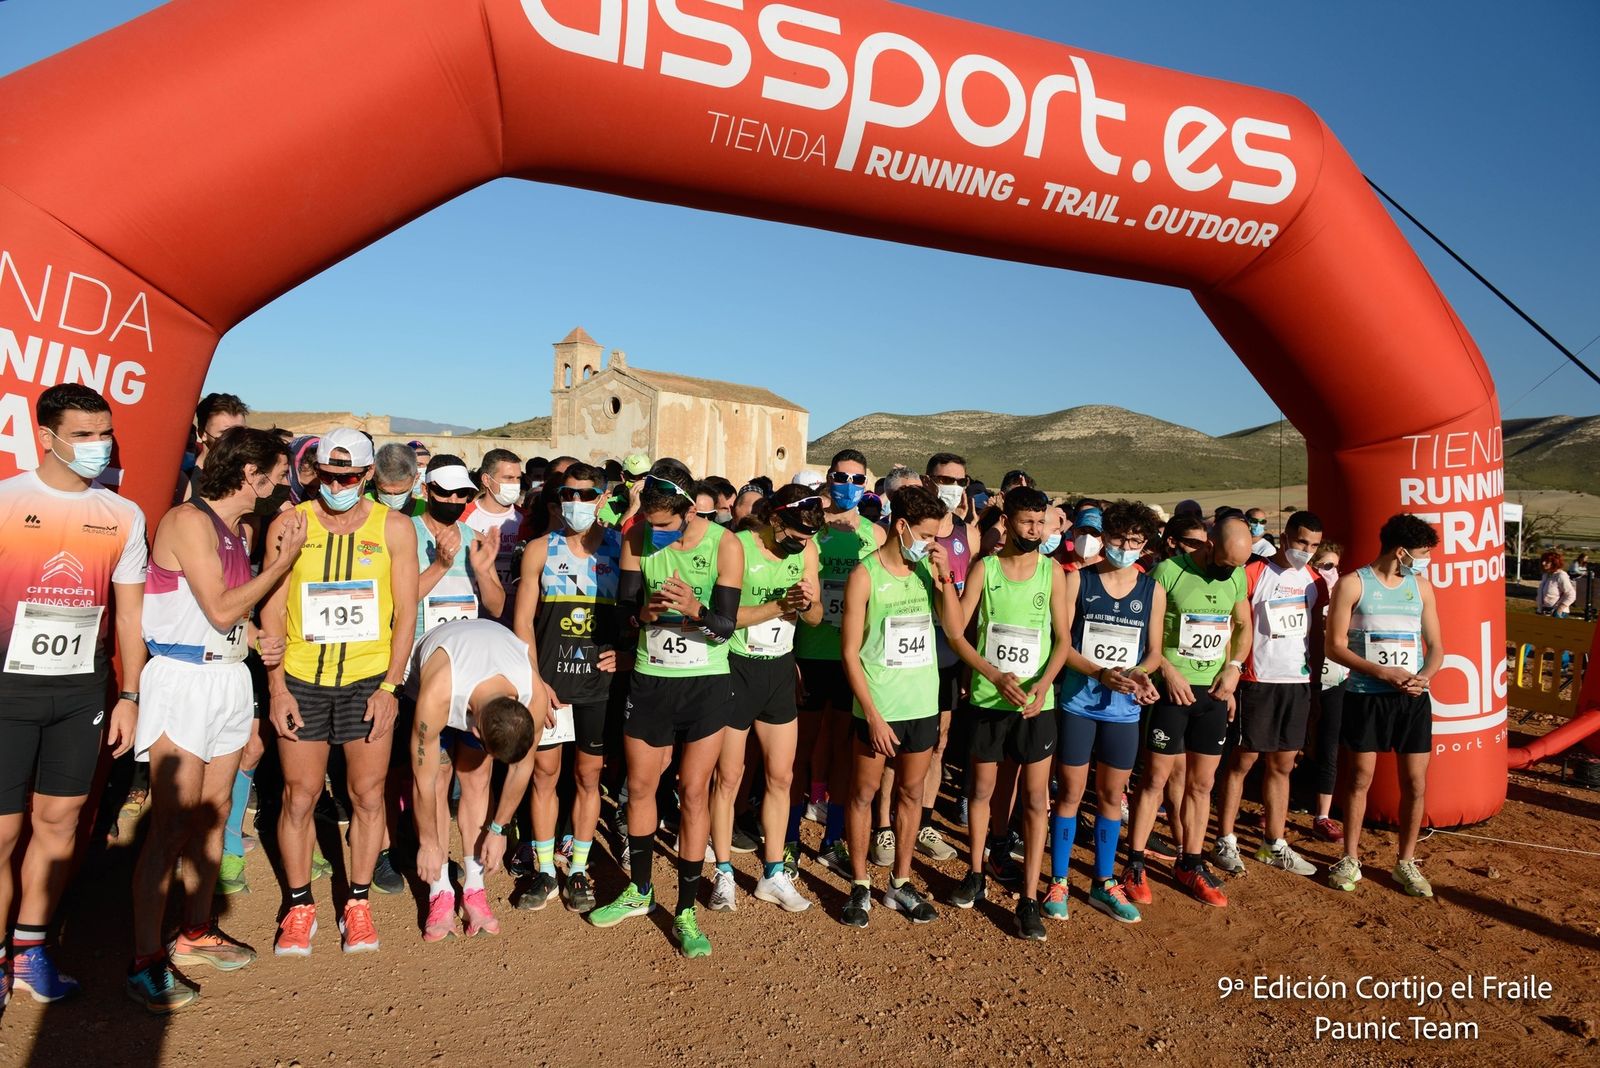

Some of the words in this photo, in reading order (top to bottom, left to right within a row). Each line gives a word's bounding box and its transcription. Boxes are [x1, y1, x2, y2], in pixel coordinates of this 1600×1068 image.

[708, 110, 827, 166] TIENDA
[864, 146, 1015, 201] RUNNING
[1041, 182, 1121, 225] TRAIL
[1144, 204, 1280, 249] OUTDOOR
[1418, 552, 1506, 588] UTDOO
[319, 605, 364, 627] 195
[1279, 613, 1304, 629] 107
[32, 633, 82, 656] 601
[226, 625, 244, 645] 47
[771, 627, 781, 643] 7
[898, 635, 926, 654] 544
[1192, 633, 1222, 649] 200
[662, 637, 688, 654] 45
[996, 644, 1030, 664] 658
[1094, 643, 1128, 663] 622
[1377, 650, 1409, 665] 312
